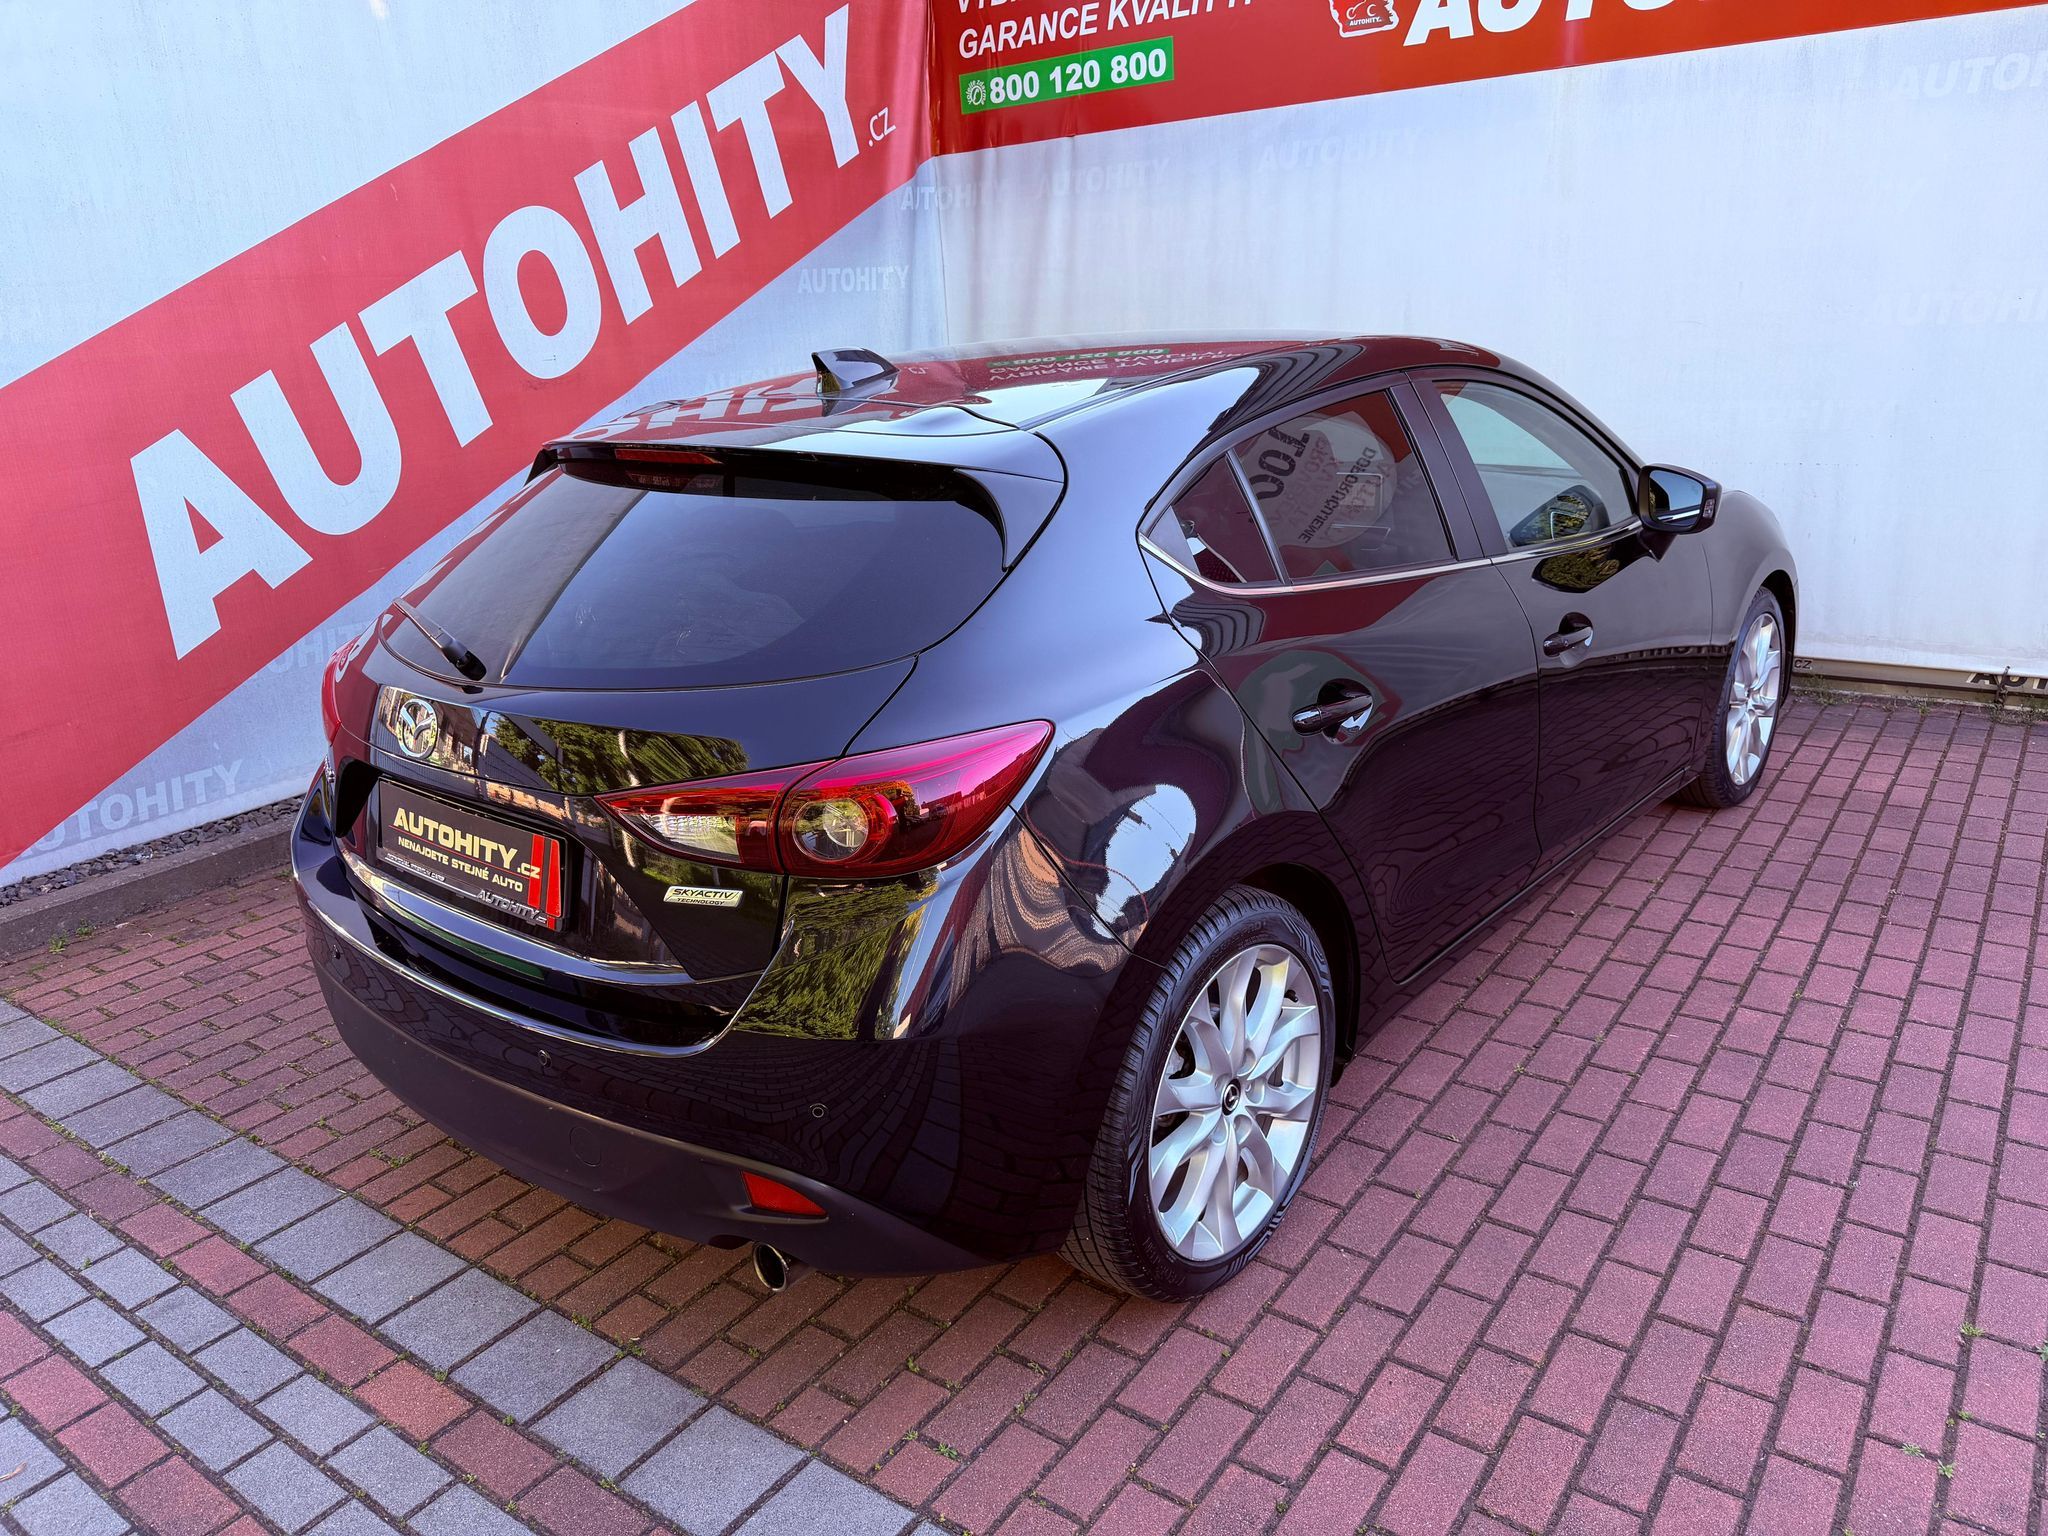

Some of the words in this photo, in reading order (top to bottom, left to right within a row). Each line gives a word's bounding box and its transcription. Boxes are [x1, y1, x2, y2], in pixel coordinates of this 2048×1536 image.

[959, 2, 1099, 58] GARANCE
[990, 71, 1039, 104] 800
[1049, 60, 1101, 93] 120
[1111, 48, 1167, 84] 800
[797, 265, 909, 294] AUTOHITY
[398, 836, 449, 866] NENAJDETE
[451, 858, 490, 881] STEJNÉ
[492, 873, 524, 893] AUTO
[672, 888, 734, 899] SKYACTIV
